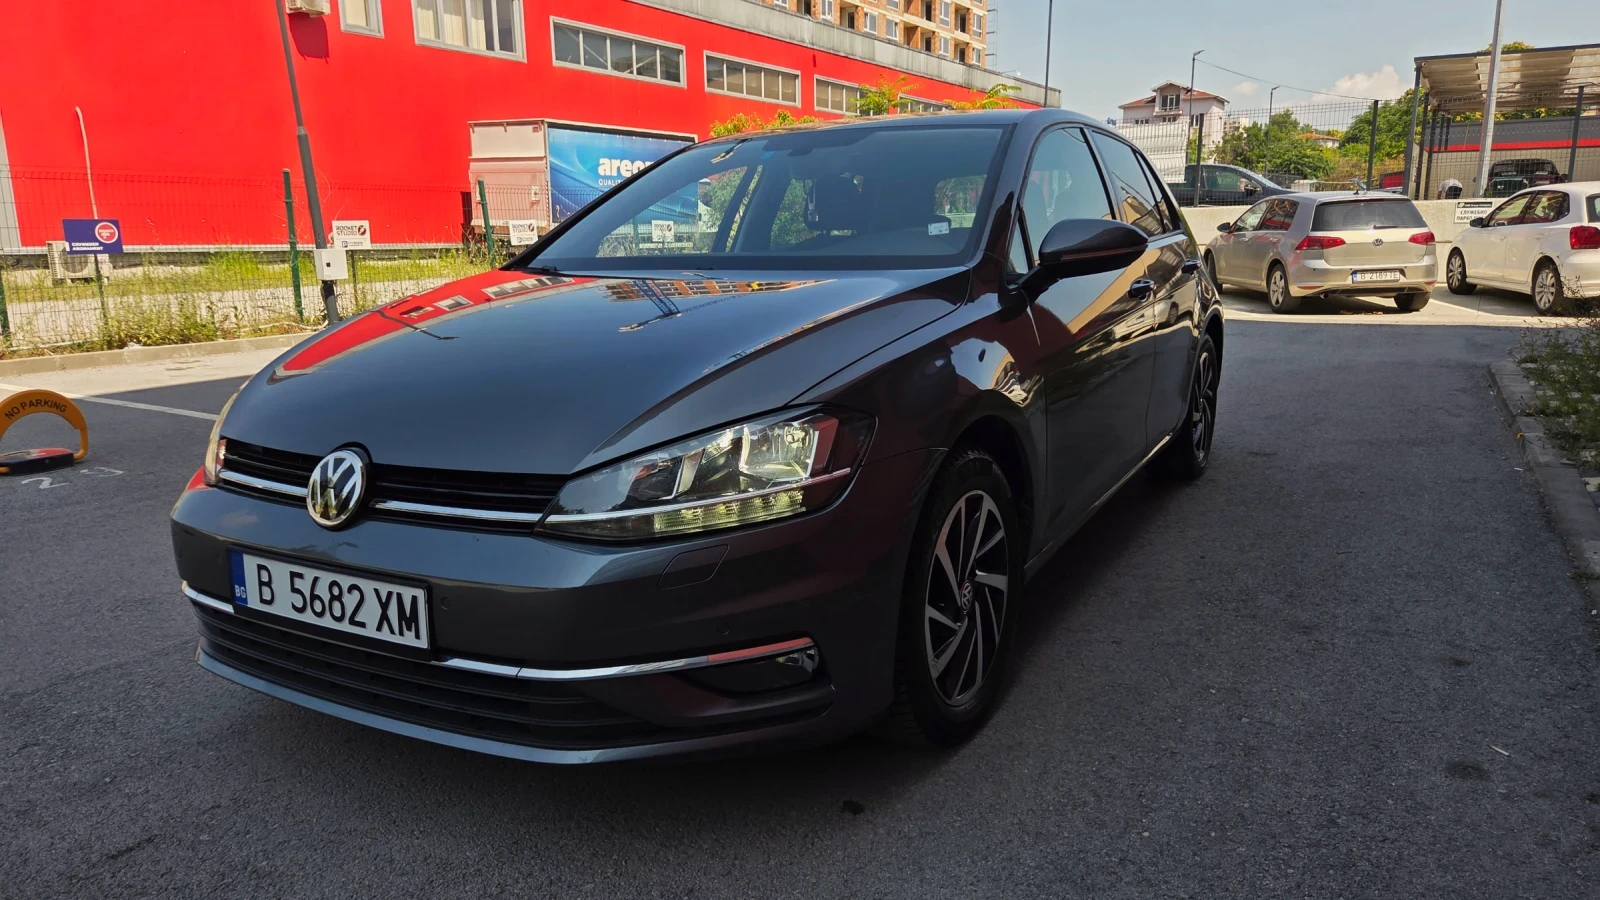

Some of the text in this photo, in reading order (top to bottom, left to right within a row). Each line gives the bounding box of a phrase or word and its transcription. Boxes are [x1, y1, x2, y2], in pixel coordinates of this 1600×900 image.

[598, 158, 655, 177] areo
[4, 399, 67, 419] NO PARKING
[234, 584, 247, 599] BG
[256, 563, 421, 640] B 5682 XM
